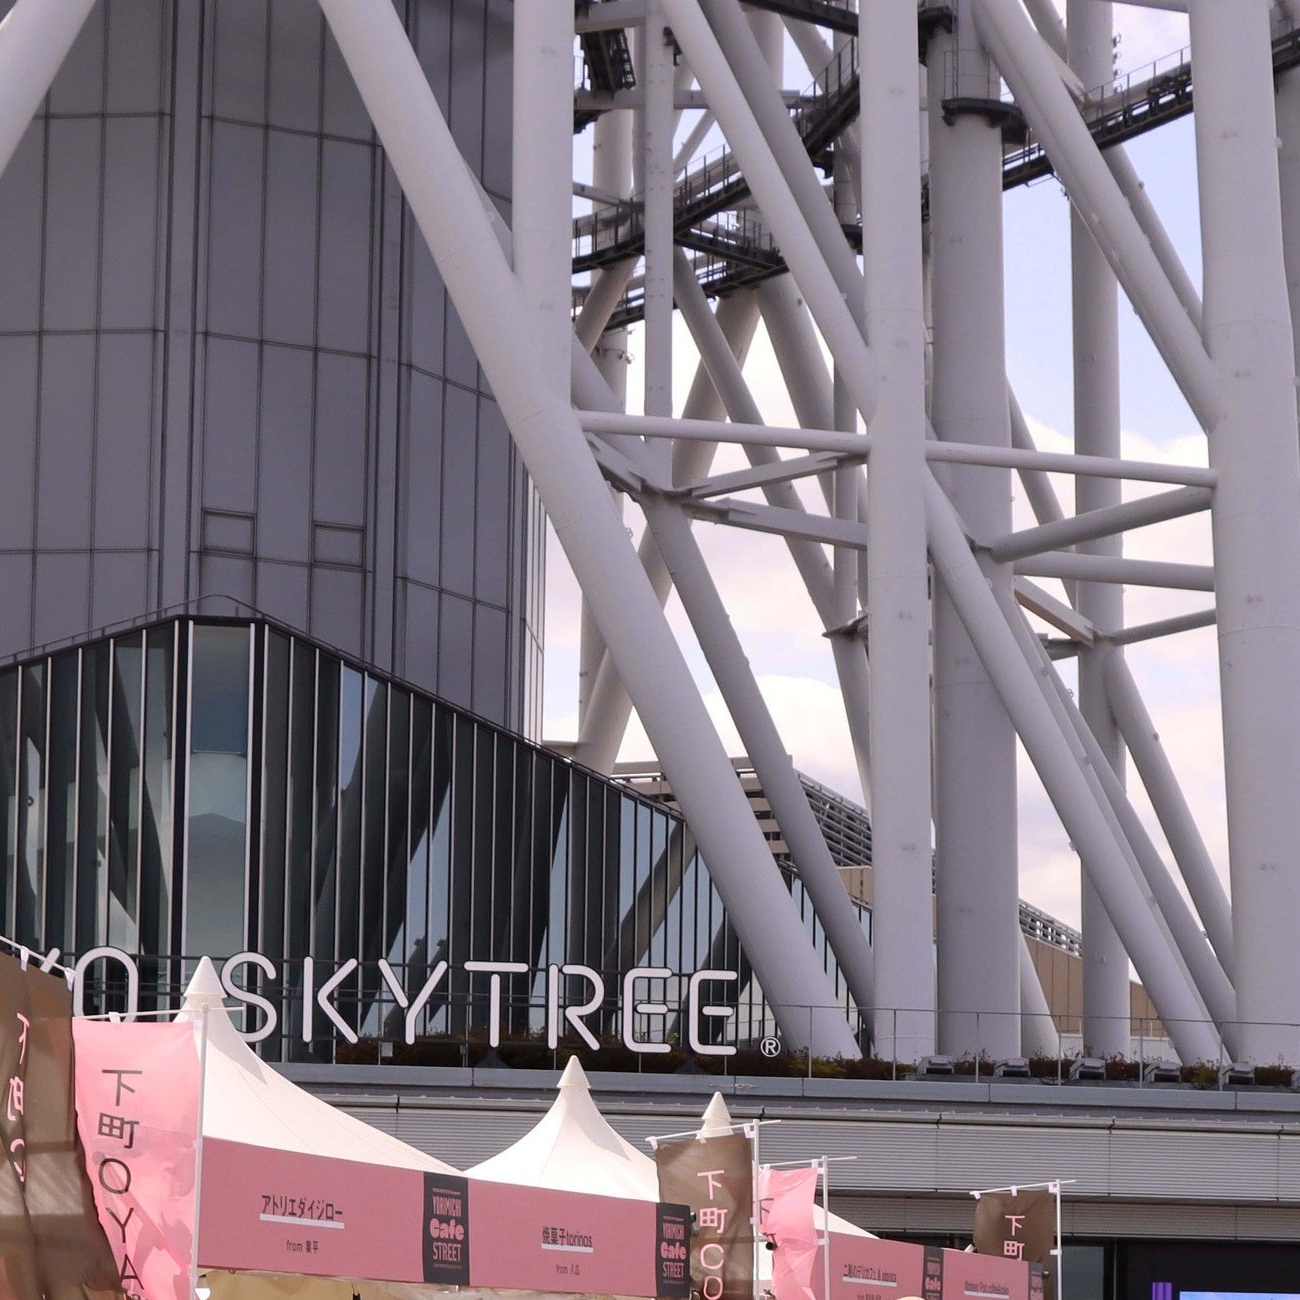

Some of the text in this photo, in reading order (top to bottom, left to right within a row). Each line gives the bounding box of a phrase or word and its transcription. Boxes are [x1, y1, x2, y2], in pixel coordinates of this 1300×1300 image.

[221, 951, 738, 1056] SKYTREE
[262, 1194, 343, 1221] アトリエダイジロー
[430, 1218, 464, 1240] Cafe
[286, 1240, 302, 1252] from
[432, 1241, 461, 1261] STREET
[660, 1241, 687, 1260] Cafe
[662, 1262, 685, 1278] STREET
